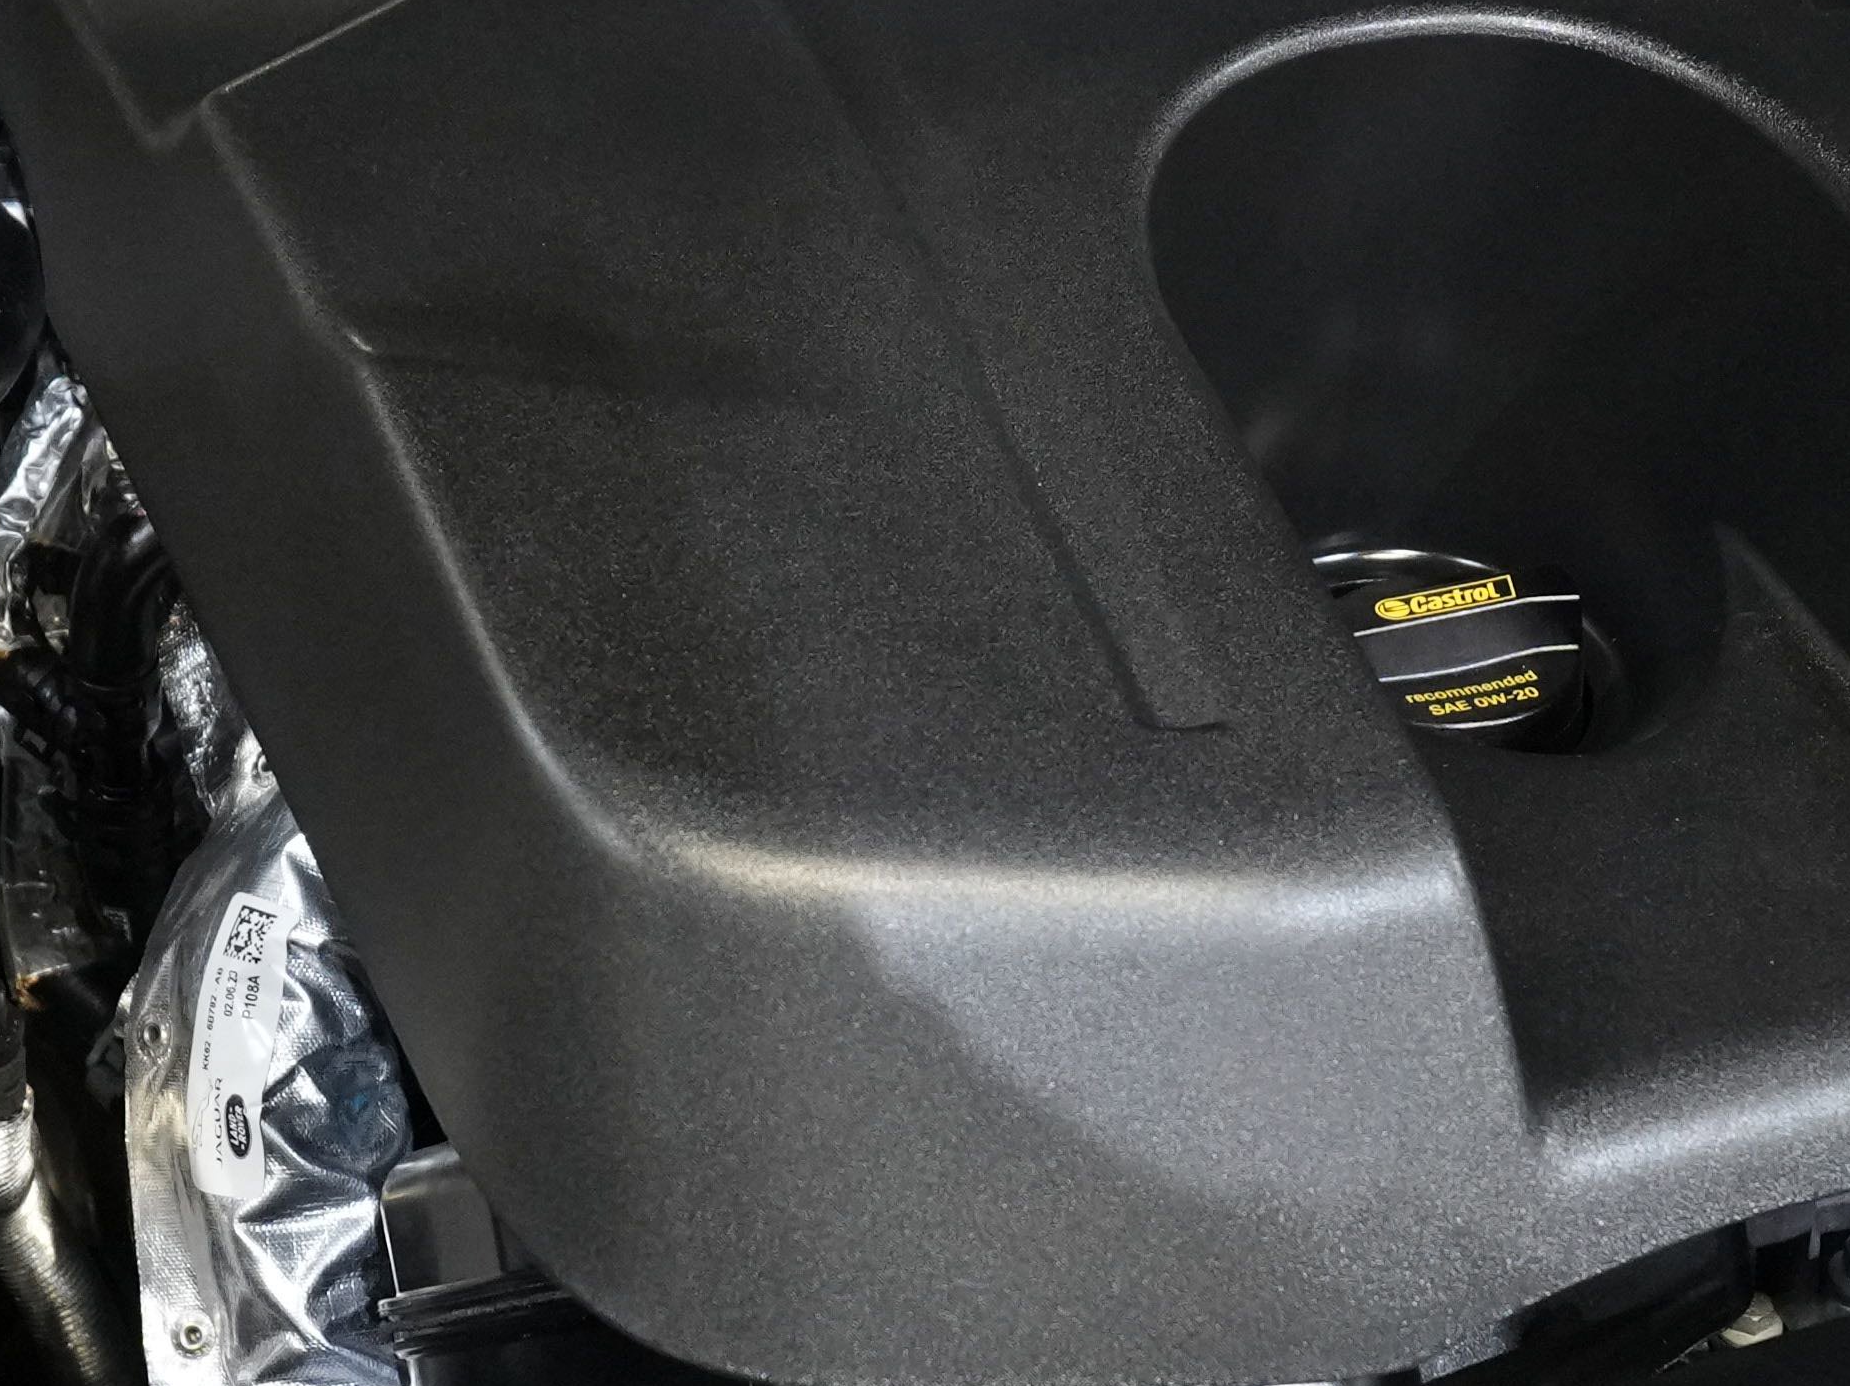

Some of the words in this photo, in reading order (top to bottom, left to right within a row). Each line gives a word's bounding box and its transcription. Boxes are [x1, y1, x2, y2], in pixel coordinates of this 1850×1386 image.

[1410, 583, 1500, 613] Castrol
[1405, 670, 1539, 704] recommended
[1429, 699, 1472, 716] SAE
[1474, 686, 1540, 708] 0W-20
[242, 975, 261, 1020] P108A
[213, 1077, 223, 1164] JAGUAR
